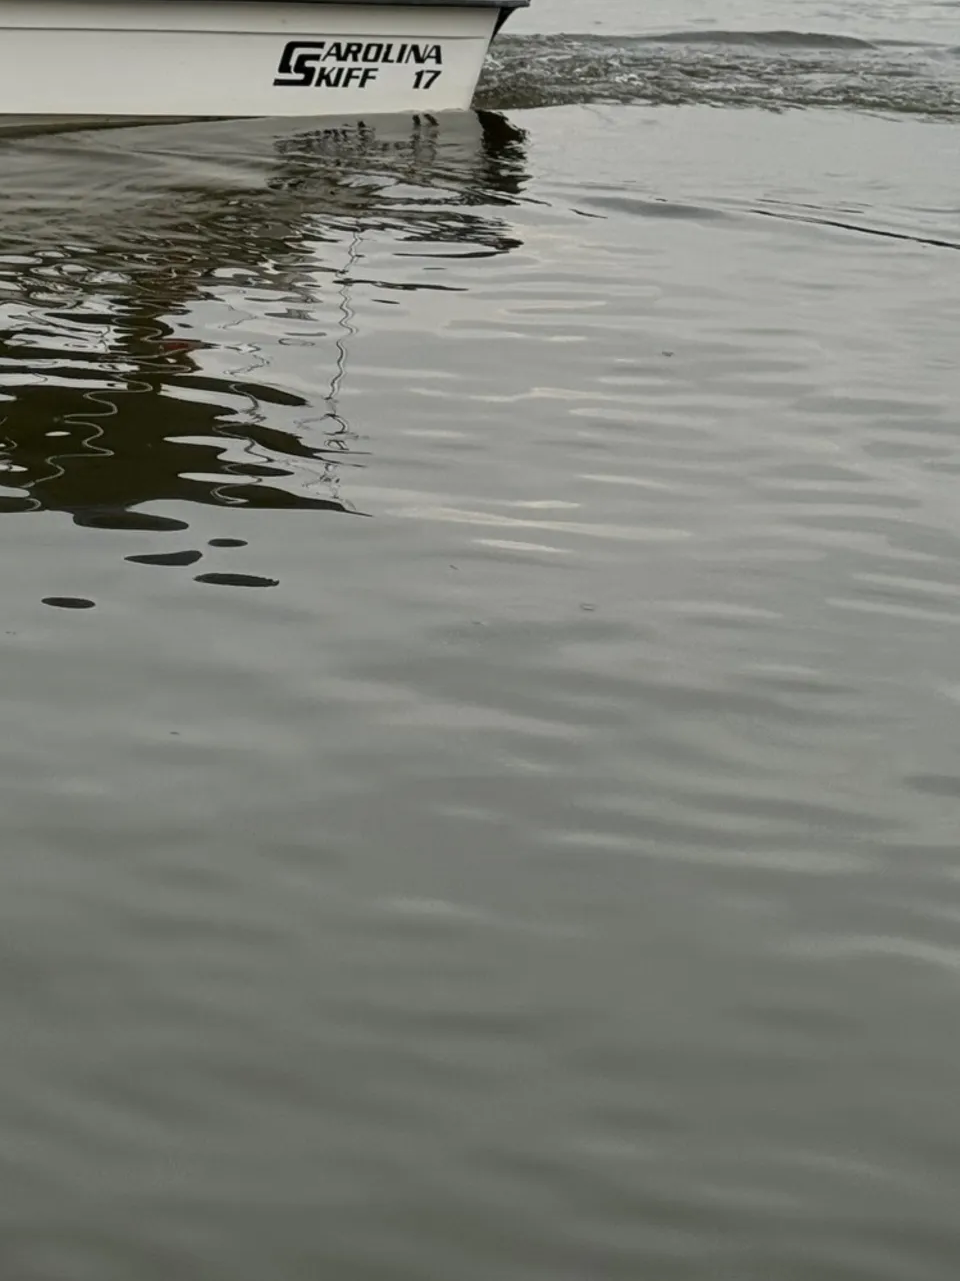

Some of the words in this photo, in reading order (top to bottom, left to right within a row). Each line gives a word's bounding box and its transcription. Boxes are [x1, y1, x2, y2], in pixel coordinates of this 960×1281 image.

[273, 54, 379, 88] SKIFF
[413, 69, 442, 89] 17
[278, 41, 442, 74] CAROLINA
